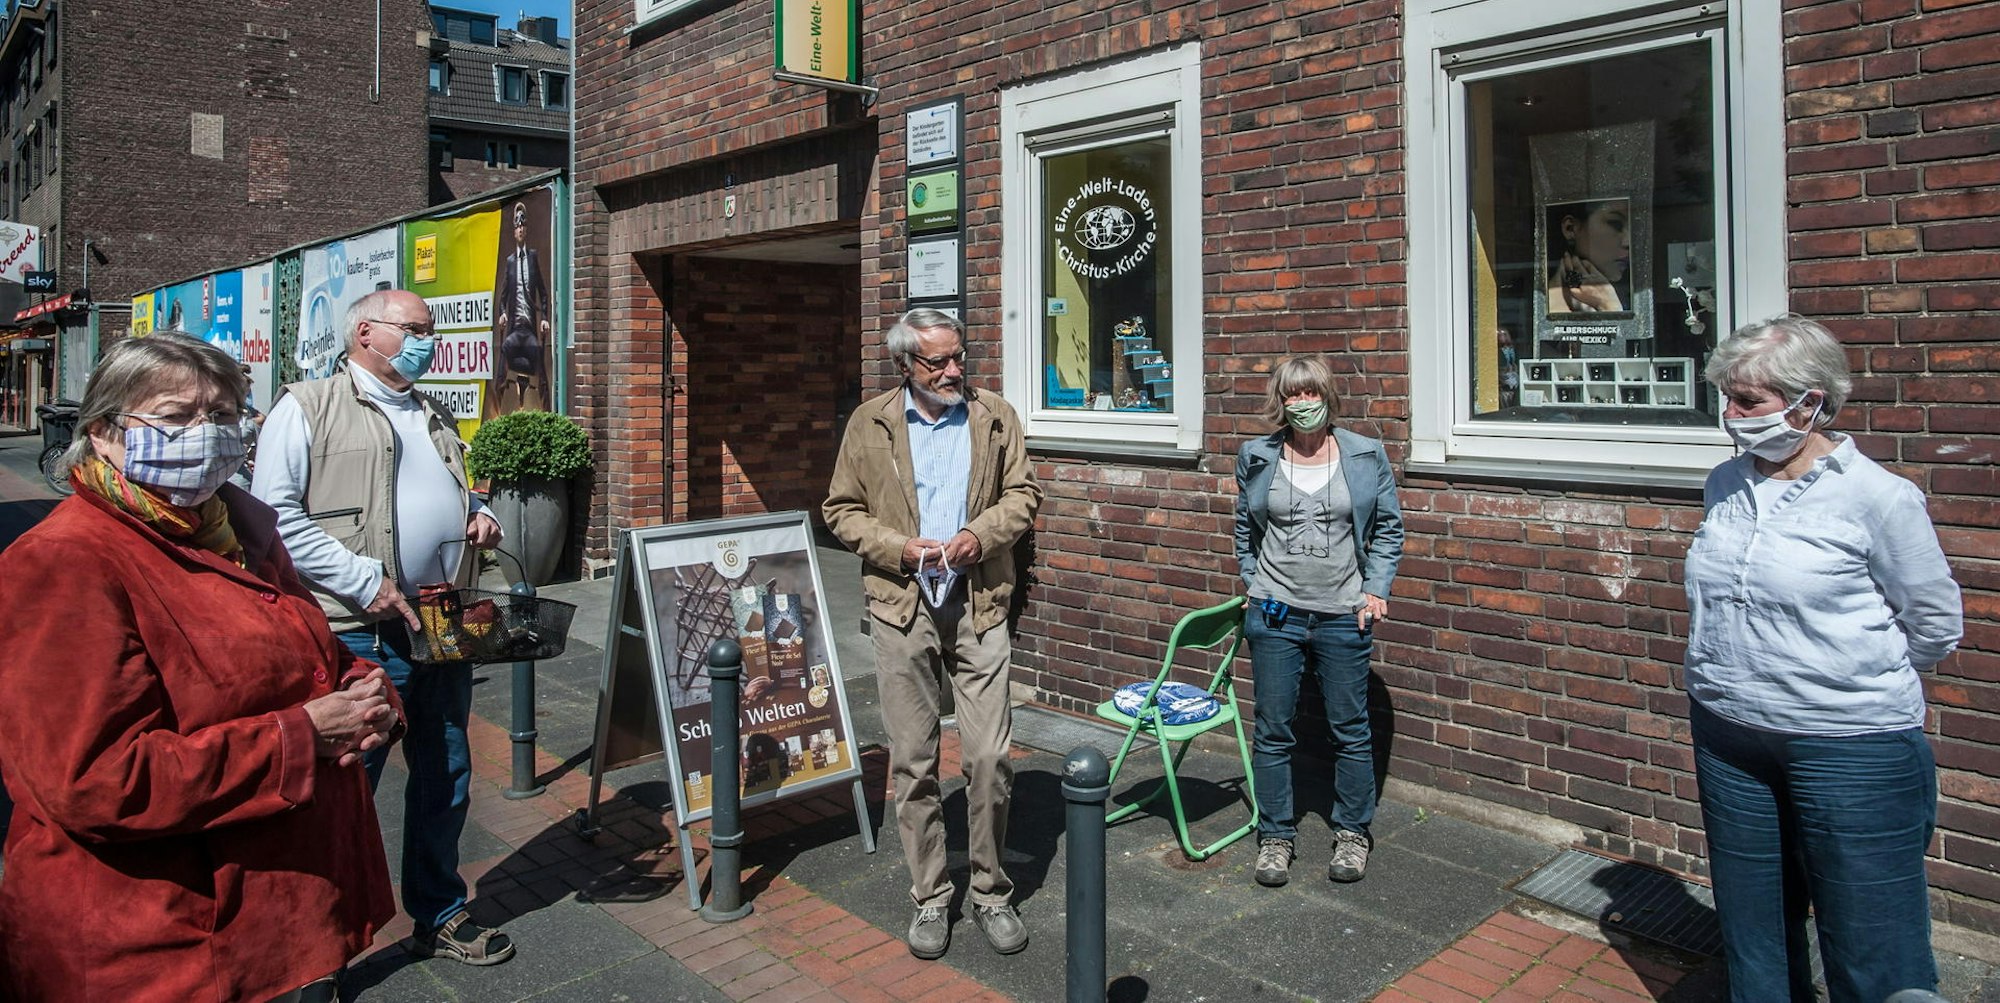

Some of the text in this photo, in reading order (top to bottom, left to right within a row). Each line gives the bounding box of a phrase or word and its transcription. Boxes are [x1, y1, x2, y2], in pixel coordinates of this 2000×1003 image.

[810, 0, 822, 72] Eine-Welt-
[346, 257, 364, 276] kaufen
[1058, 231, 1156, 279] Christus-Kirche
[28, 276, 53, 288] sky
[465, 298, 489, 322] EINE
[1554, 326, 1618, 334] SILBERSCHMUCK
[1579, 335, 1608, 344] MEXIKO
[243, 329, 271, 363] halbe
[301, 326, 335, 361] Rheinfels
[458, 340, 489, 374] EUR
[717, 540, 738, 549] GEPA
[745, 701, 807, 726] Welten
